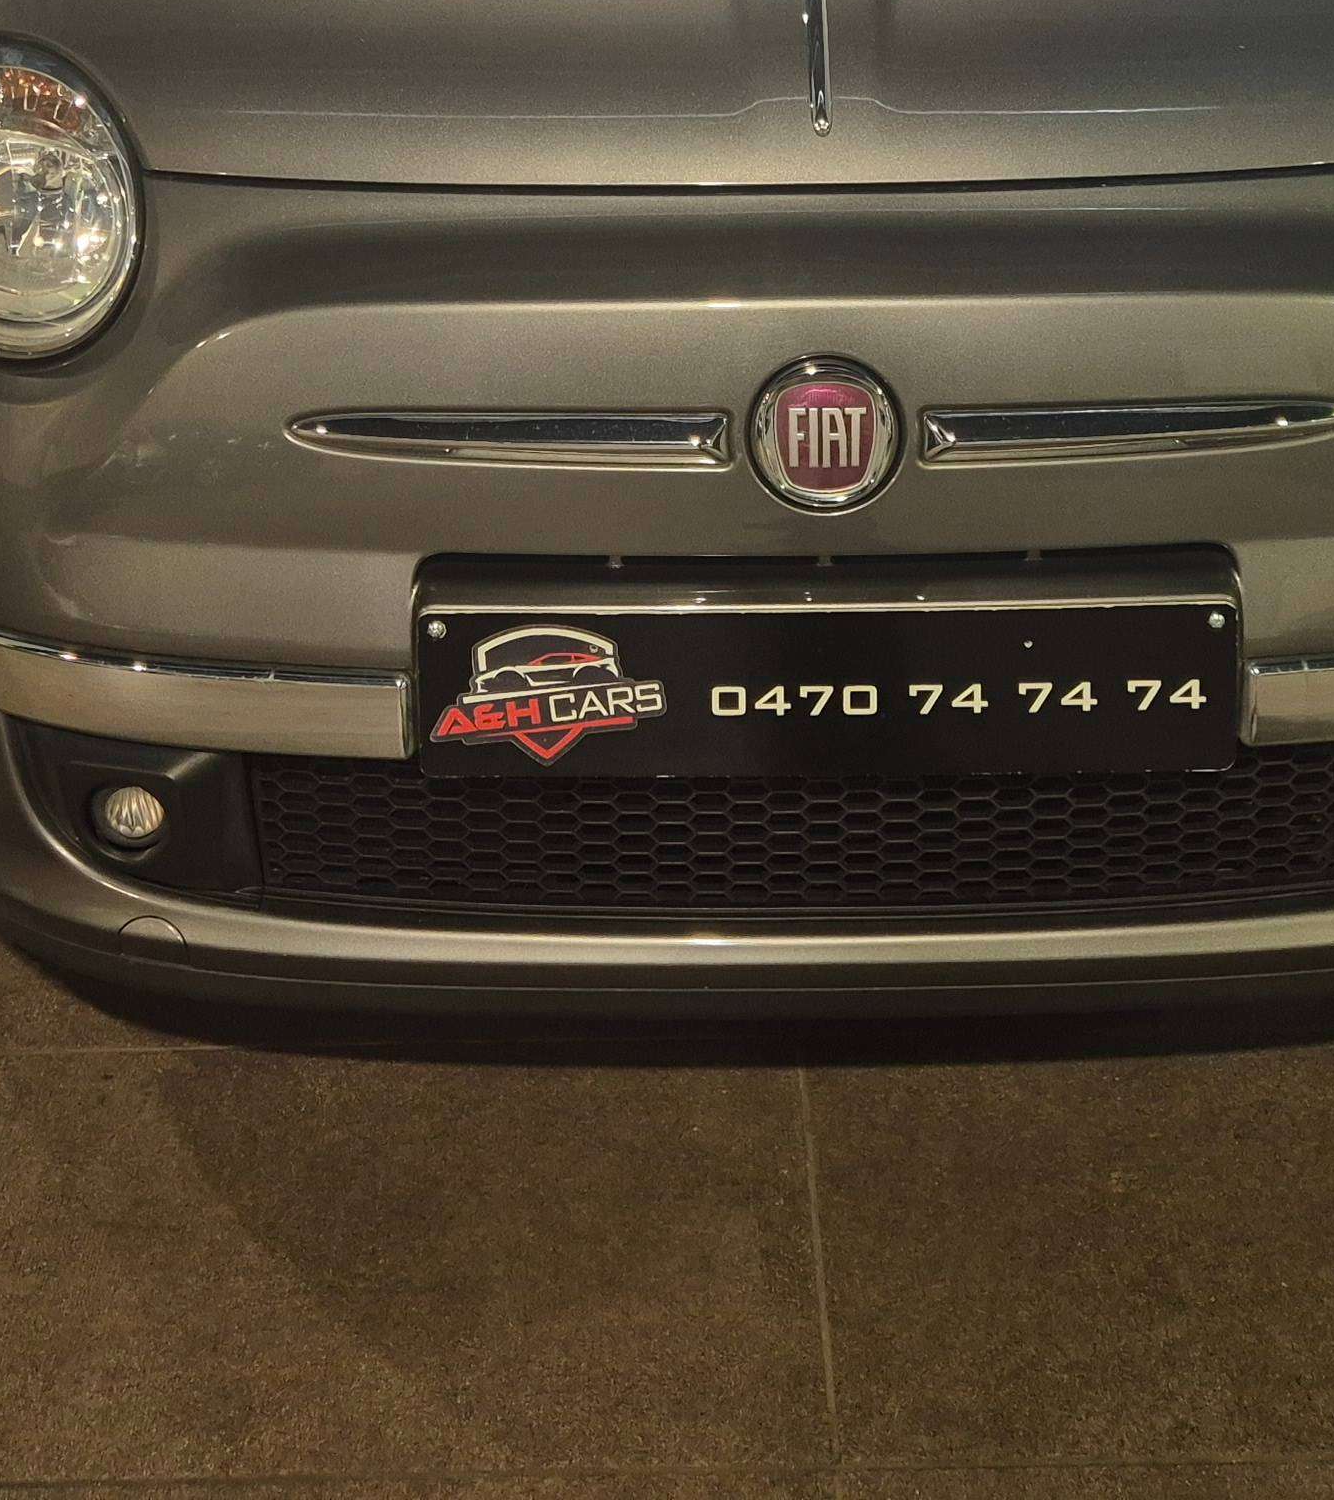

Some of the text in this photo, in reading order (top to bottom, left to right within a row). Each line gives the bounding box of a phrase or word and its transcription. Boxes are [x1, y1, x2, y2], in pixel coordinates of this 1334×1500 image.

[788, 407, 867, 468] FIAT
[437, 683, 663, 736] A&H CARS
[711, 679, 1207, 716] 0470 74 74 74
